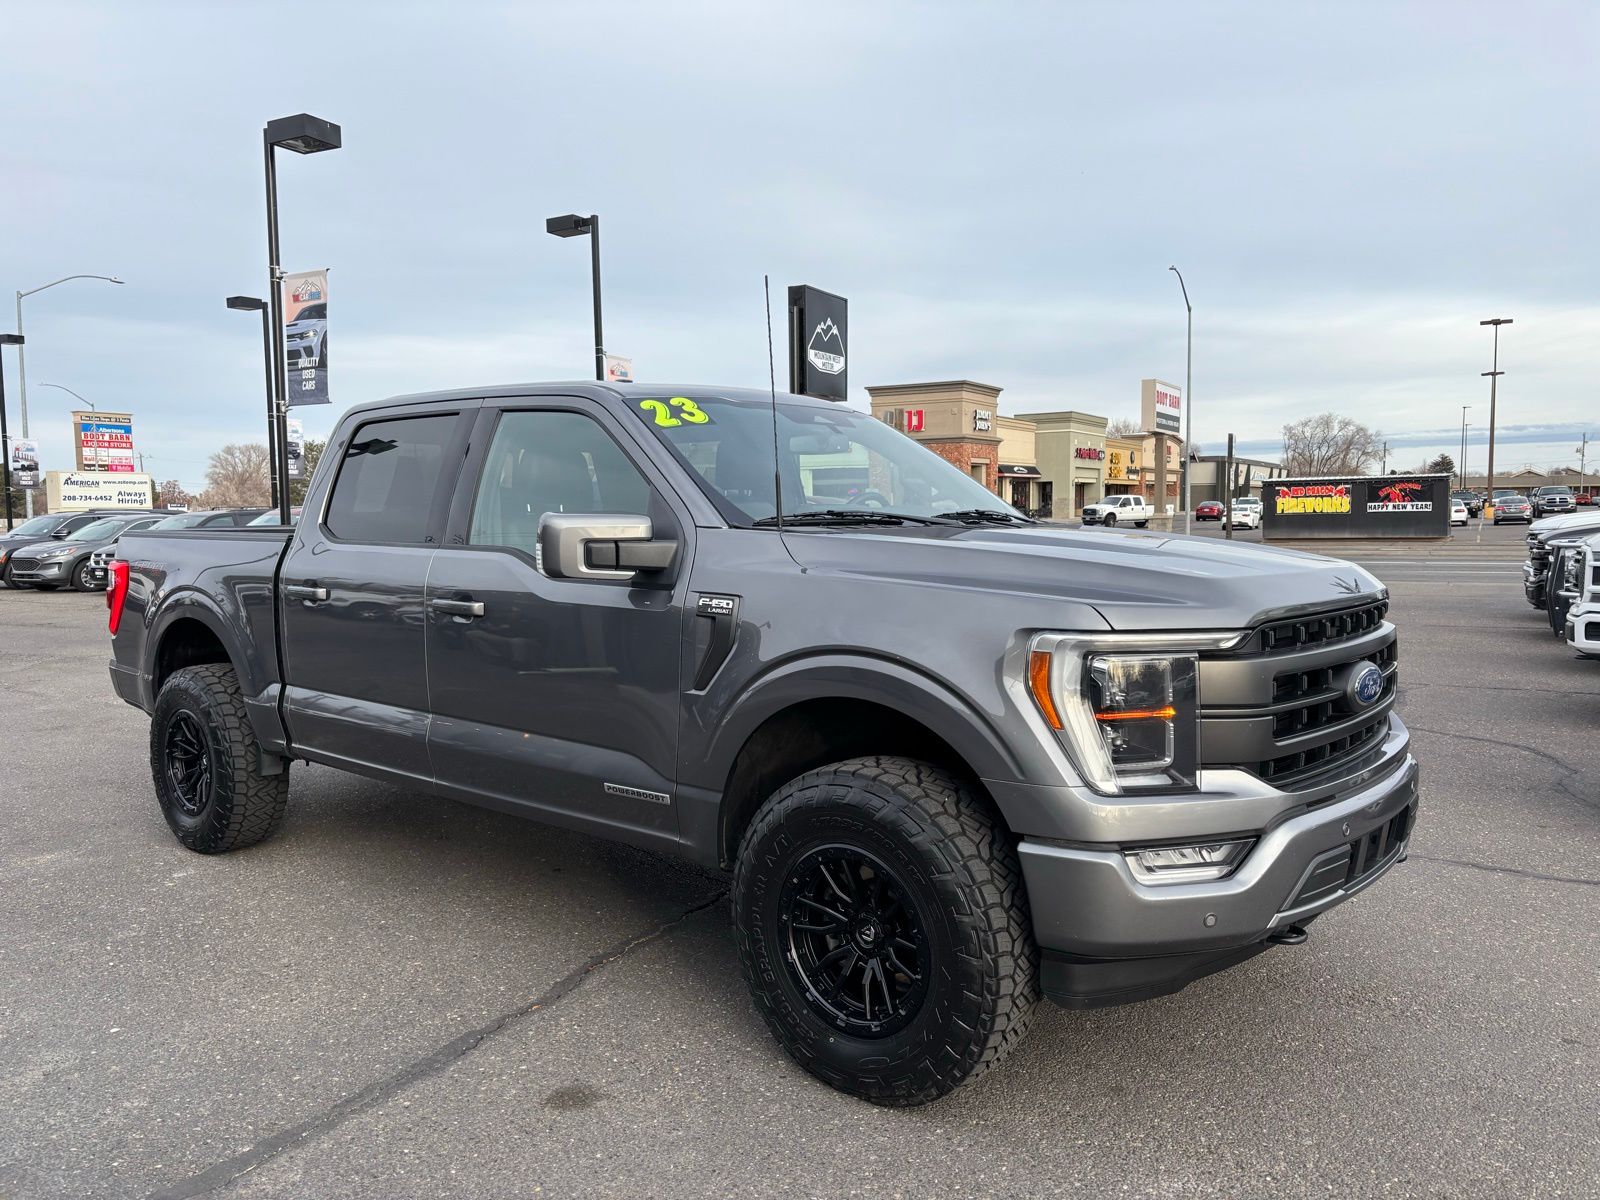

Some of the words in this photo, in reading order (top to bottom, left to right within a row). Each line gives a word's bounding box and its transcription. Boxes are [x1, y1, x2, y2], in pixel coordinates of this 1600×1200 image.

[302, 369, 316, 379] USED
[302, 380, 316, 391] CARS
[1156, 390, 1168, 407] BOOT
[640, 397, 709, 427] 23
[63, 478, 100, 486] AMERICAN
[117, 490, 146, 498] Always
[1290, 486, 1305, 496] RED
[1306, 485, 1336, 496] DRAGON
[62, 494, 113, 502] 208-734-6452
[117, 497, 147, 505] Hiring!
[1276, 496, 1350, 514] FIREWORKS
[1368, 503, 1390, 511] HAPPY
[698, 597, 734, 609] F-150
[707, 607, 731, 615] LARIAT
[605, 784, 667, 802] POWERBOOST
